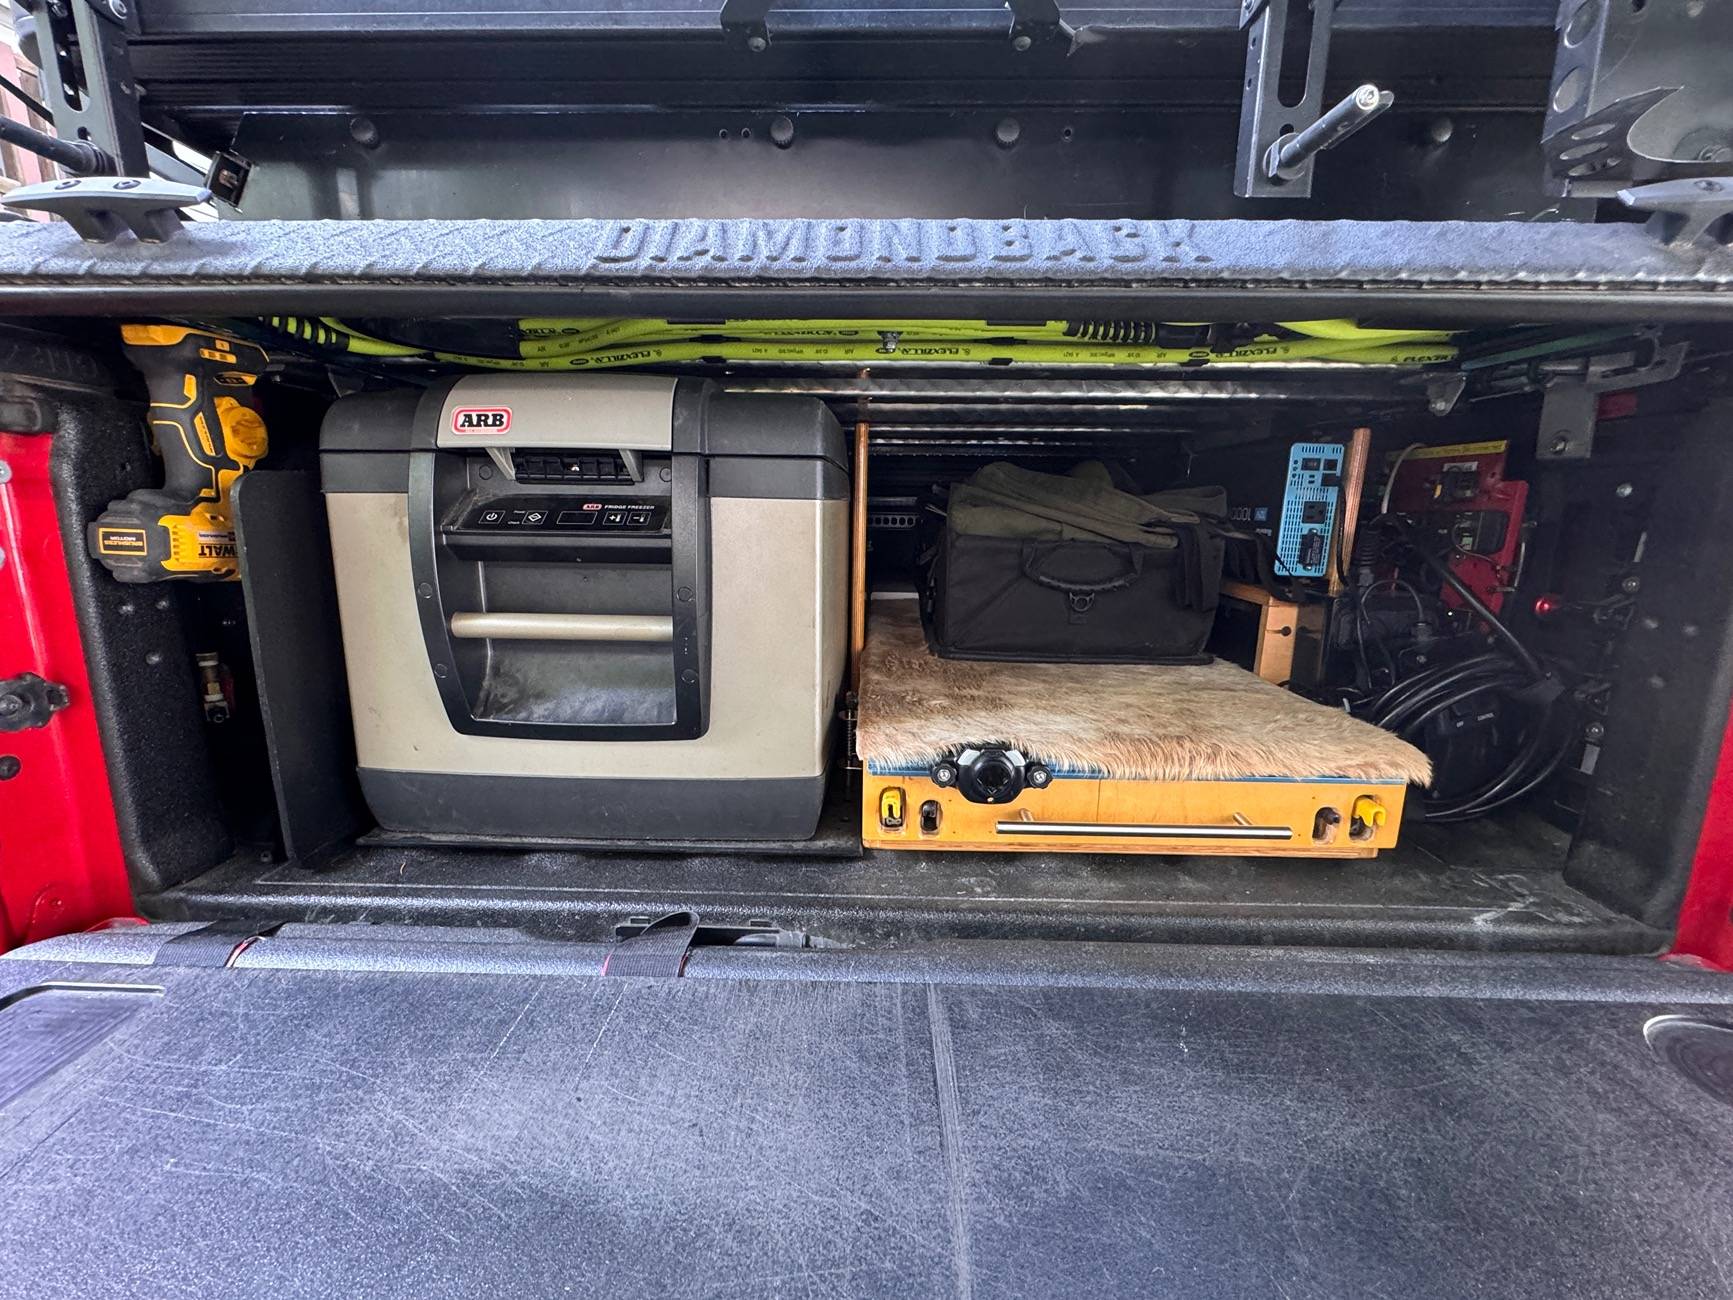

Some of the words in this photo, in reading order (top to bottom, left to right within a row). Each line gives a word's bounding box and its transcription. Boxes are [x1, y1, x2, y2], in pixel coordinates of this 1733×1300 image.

[595, 223, 1214, 264] DIAMONDBACK
[594, 350, 651, 364] FLEXZILLA
[901, 347, 959, 356] FLEXZILLA
[459, 413, 505, 428] ARB
[198, 545, 237, 557] WALT
